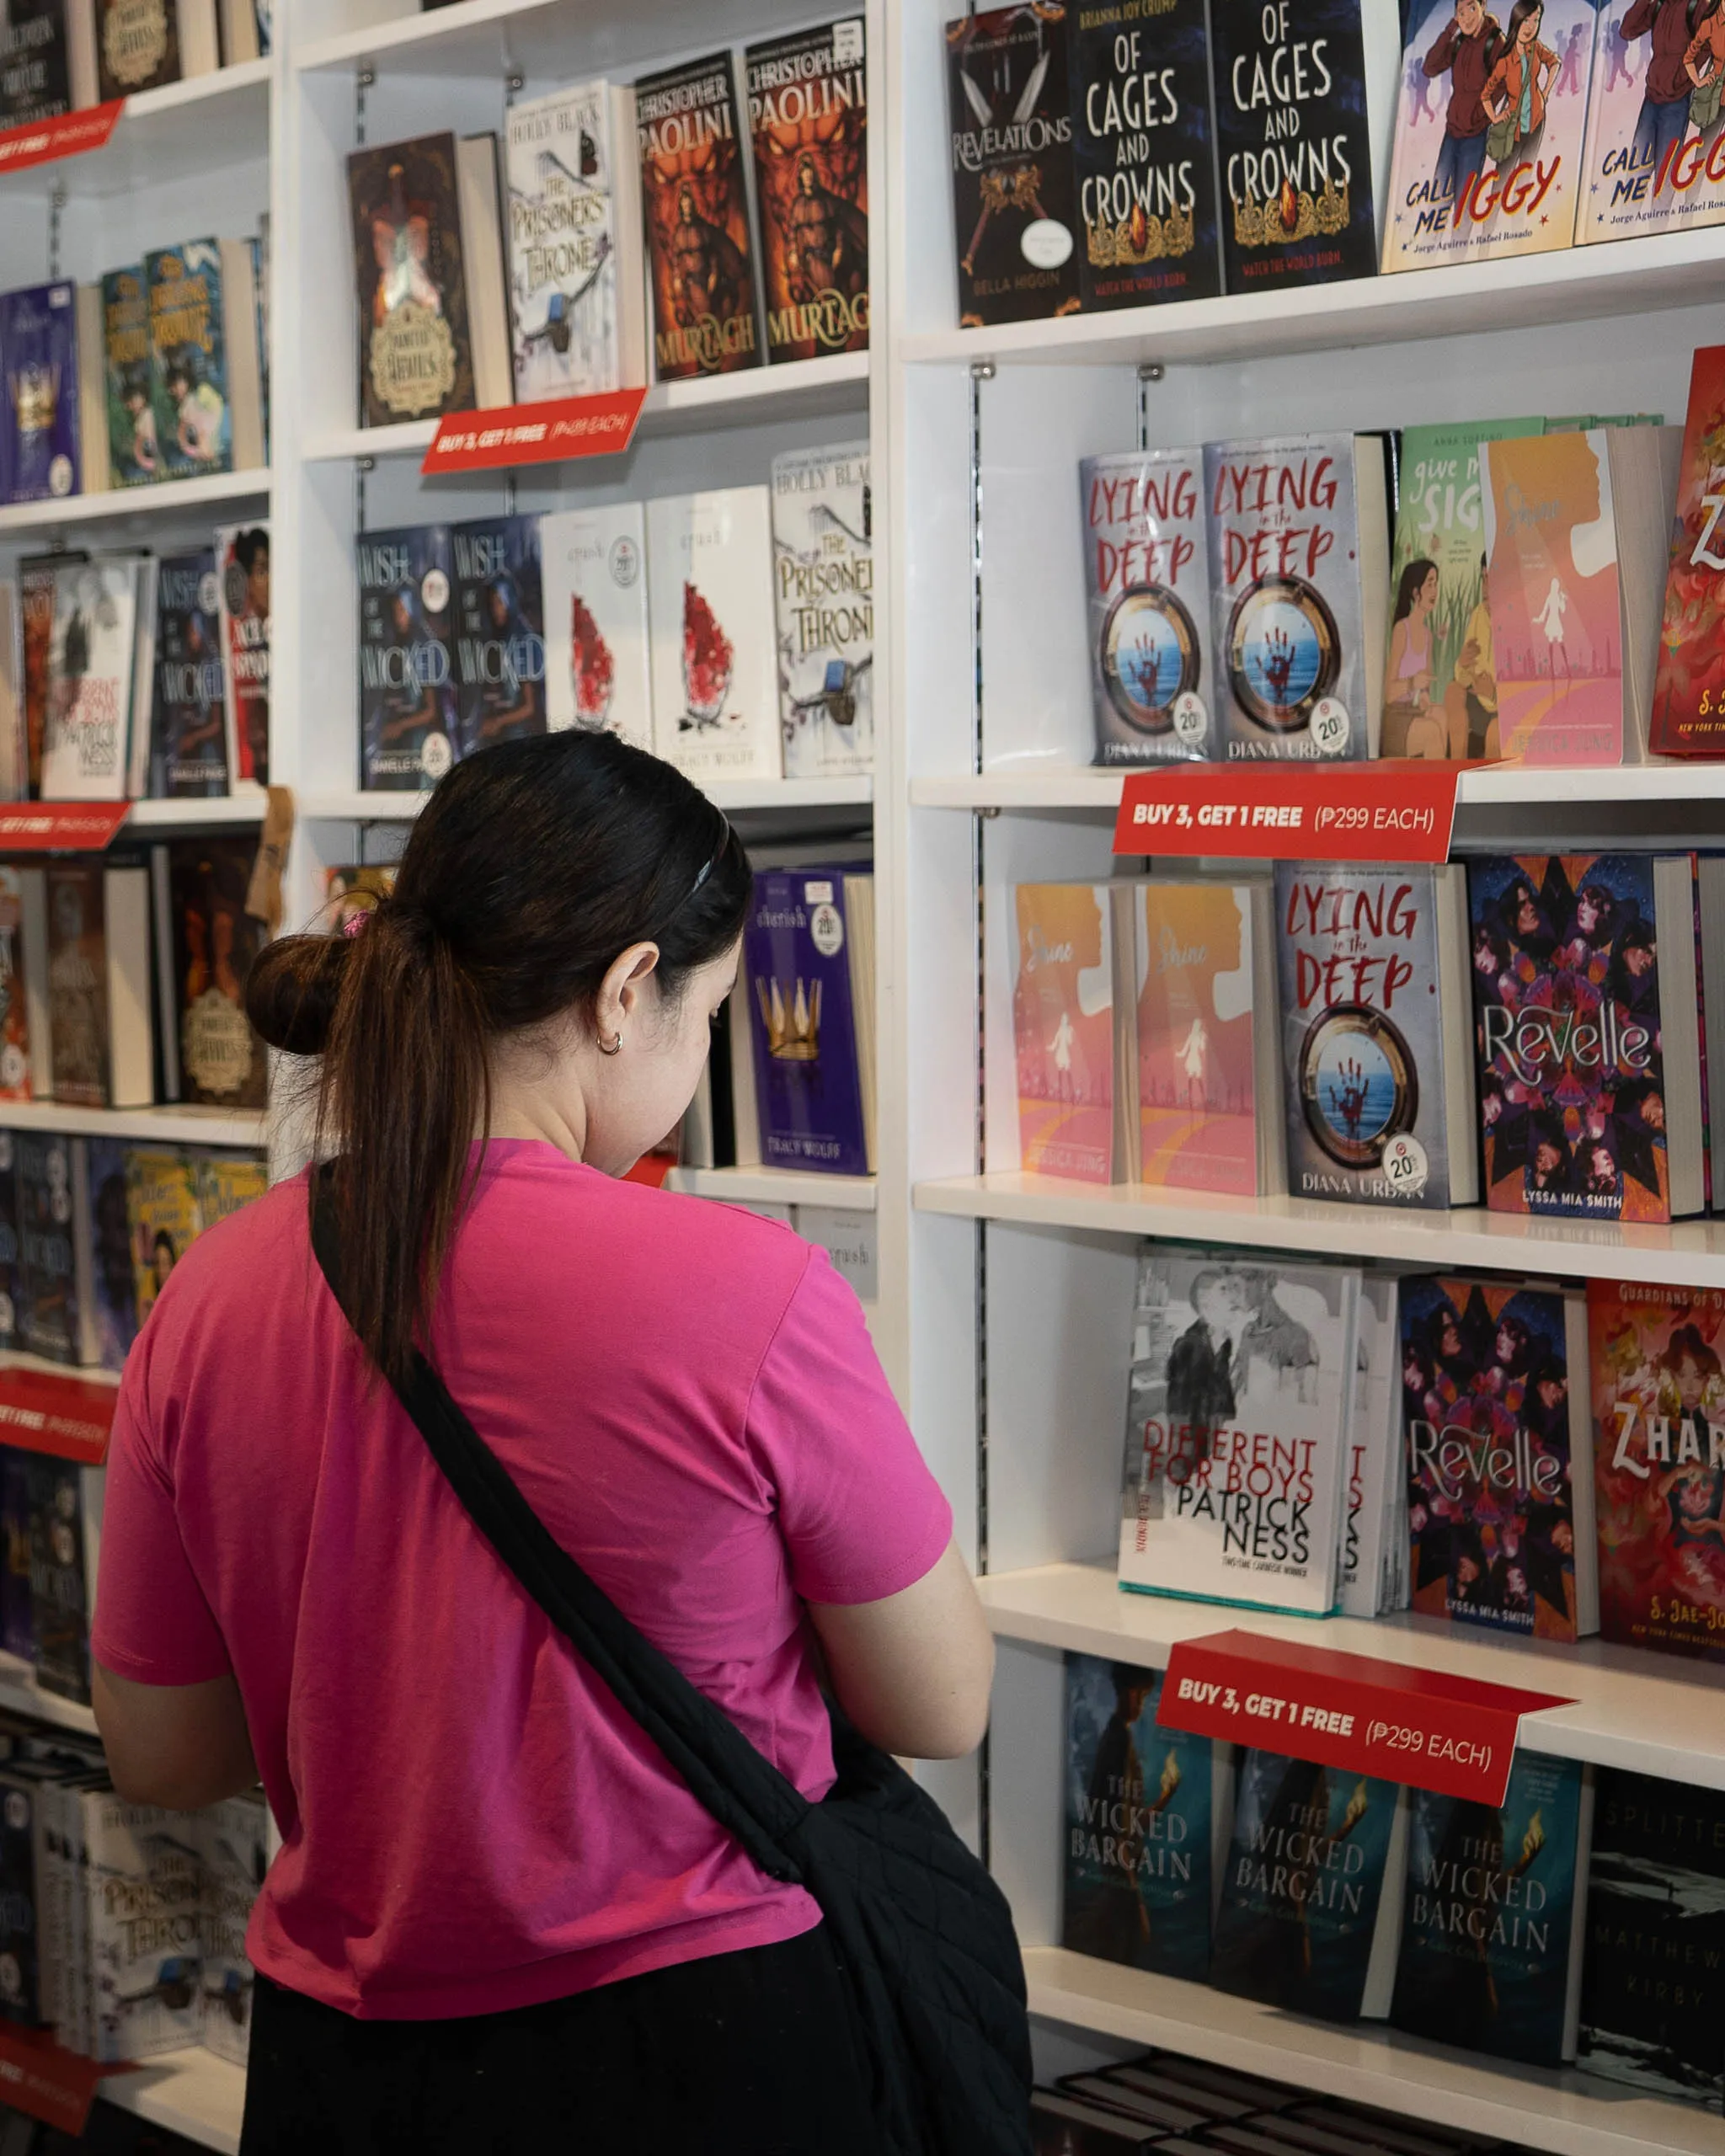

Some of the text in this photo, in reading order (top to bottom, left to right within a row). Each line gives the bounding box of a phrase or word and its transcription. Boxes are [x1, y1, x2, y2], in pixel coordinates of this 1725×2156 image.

[1262, 2, 1290, 44] OF
[1114, 32, 1141, 74] OF
[1232, 39, 1332, 111] CAGES
[747, 70, 867, 135] PAOLINI
[1087, 69, 1178, 137] CAGES
[1264, 107, 1300, 142] AND
[637, 103, 734, 161] PAOLINI
[952, 116, 1072, 172] REVELATIONS
[1116, 133, 1150, 167] AND
[1227, 135, 1351, 205] CROWNS
[1603, 141, 1654, 177] CALL
[1081, 160, 1195, 227] CROWNS
[1406, 173, 1455, 208] CALL
[1453, 155, 1562, 230] IGGY
[1610, 173, 1653, 209] ME
[1610, 212, 1635, 227] Jorge
[1635, 208, 1670, 222] Aguirre
[1678, 201, 1707, 216] Rafael
[1414, 205, 1452, 237] ME
[1435, 237, 1468, 251] Aguirre
[1476, 232, 1503, 245] Rafael
[1503, 228, 1533, 243] Rosado
[1271, 258, 1286, 274] THE
[655, 313, 756, 371] MURTAGH
[1089, 469, 1198, 527] LYING
[1214, 456, 1338, 517] LYING
[1409, 457, 1457, 504] give
[1097, 533, 1194, 594] DEEP
[1226, 524, 1333, 585] DEEP
[362, 638, 450, 696] WICKED
[458, 633, 546, 691] WICKED
[1180, 712, 1197, 730] 20
[1318, 718, 1338, 740] 20
[1229, 740, 1279, 759] DIANA
[1287, 741, 1346, 759] URB
[1133, 804, 1174, 825] BUY
[1175, 804, 1193, 830] 3,
[1198, 805, 1236, 826] GET
[1240, 806, 1249, 826] 1
[1252, 806, 1303, 828] FREE
[1373, 807, 1434, 835] EACH)
[1286, 883, 1418, 941] LYING
[1296, 947, 1413, 1010] DEEP
[1484, 1001, 1652, 1087] Revelle
[1302, 1171, 1352, 1195] DIANA
[1391, 1155, 1413, 1179] 20
[1523, 1190, 1623, 1209] LYSSA MIA SMITH
[1619, 1283, 1688, 1306] GUARDIANS
[1693, 1294, 1708, 1306] OF
[1143, 1419, 1317, 1472] DIFFERENT
[1410, 1419, 1562, 1502] Revelle
[1149, 1448, 1314, 1502] FOR BOYS
[1178, 1484, 1312, 1537] PATRICK
[1222, 1520, 1310, 1564] NESS
[1445, 1599, 1535, 1626] LYSSA MIA SMITH
[1651, 1595, 1666, 1620] S.
[1178, 1678, 1220, 1706] BUY
[1221, 1688, 1242, 1716] 3,
[1244, 1694, 1284, 1721] GET
[1288, 1701, 1300, 1723] 1
[1300, 1706, 1355, 1737] FREE
[1427, 1734, 1493, 1774] EACH)
[1107, 1774, 1143, 1801] THE
[1075, 1797, 1188, 1844] WICKED
[1289, 1801, 1329, 1828] THE
[1071, 1828, 1192, 1882] BARGAIN
[1247, 1824, 1365, 1876] WICKED
[1461, 1835, 1503, 1865] THE
[1236, 1857, 1364, 1914] BARGAIN
[1422, 1858, 1547, 1912] WICKED
[1413, 1894, 1550, 1953] BARGAIN
